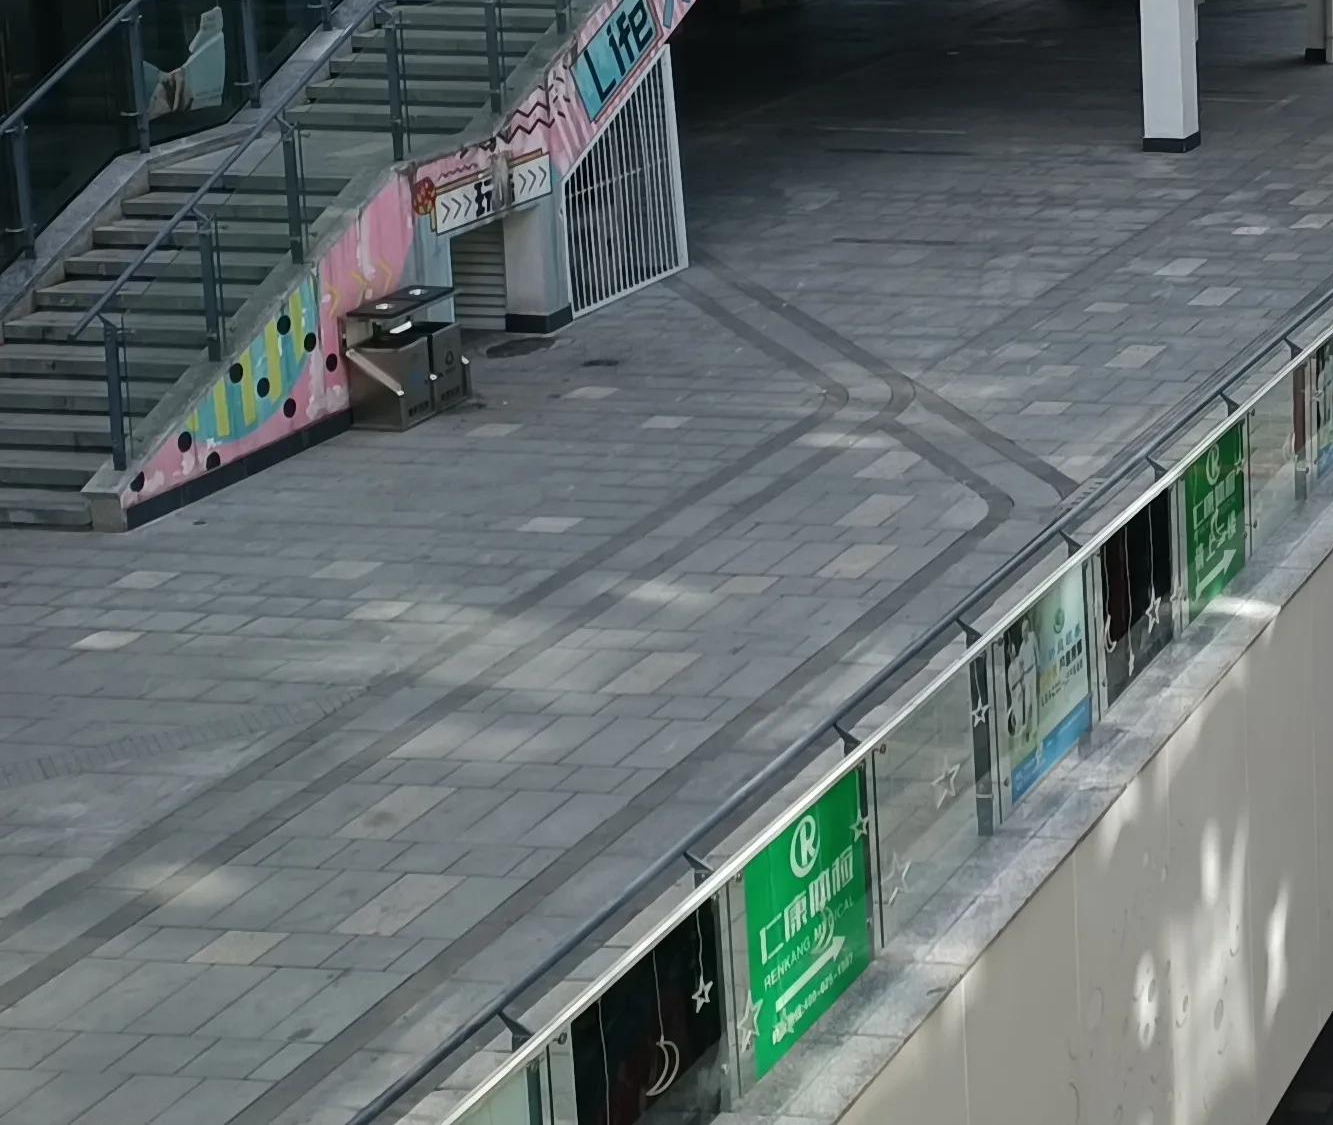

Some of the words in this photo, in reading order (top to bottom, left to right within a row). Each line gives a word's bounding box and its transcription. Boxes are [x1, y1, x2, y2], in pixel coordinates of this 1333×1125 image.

[584, 0, 653, 103] Life
[760, 845, 854, 965] 仁康体检
[764, 935, 811, 991] RENKANG
